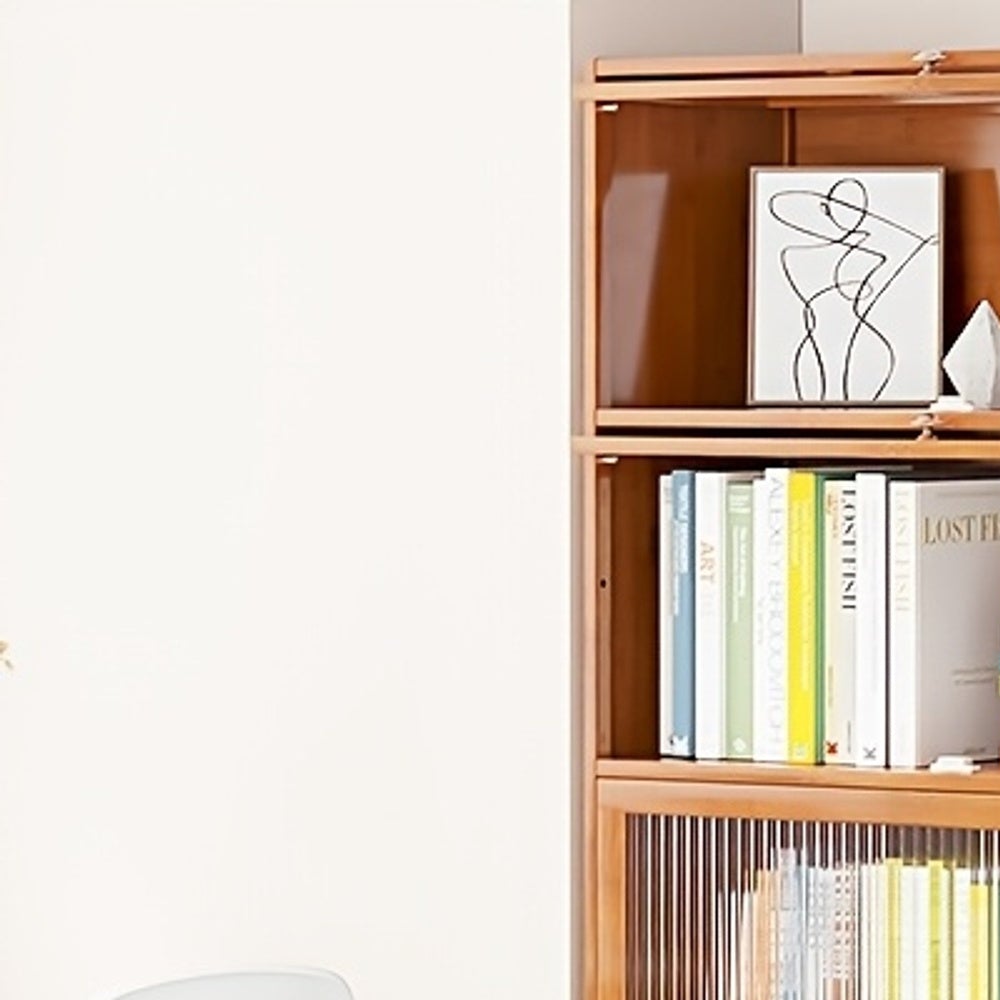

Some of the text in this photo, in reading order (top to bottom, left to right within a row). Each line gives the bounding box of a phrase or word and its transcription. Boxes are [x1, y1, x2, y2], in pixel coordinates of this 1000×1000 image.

[842, 489, 856, 610] LOST FISH
[922, 514, 976, 544] LOST
[700, 540, 715, 585] ART
